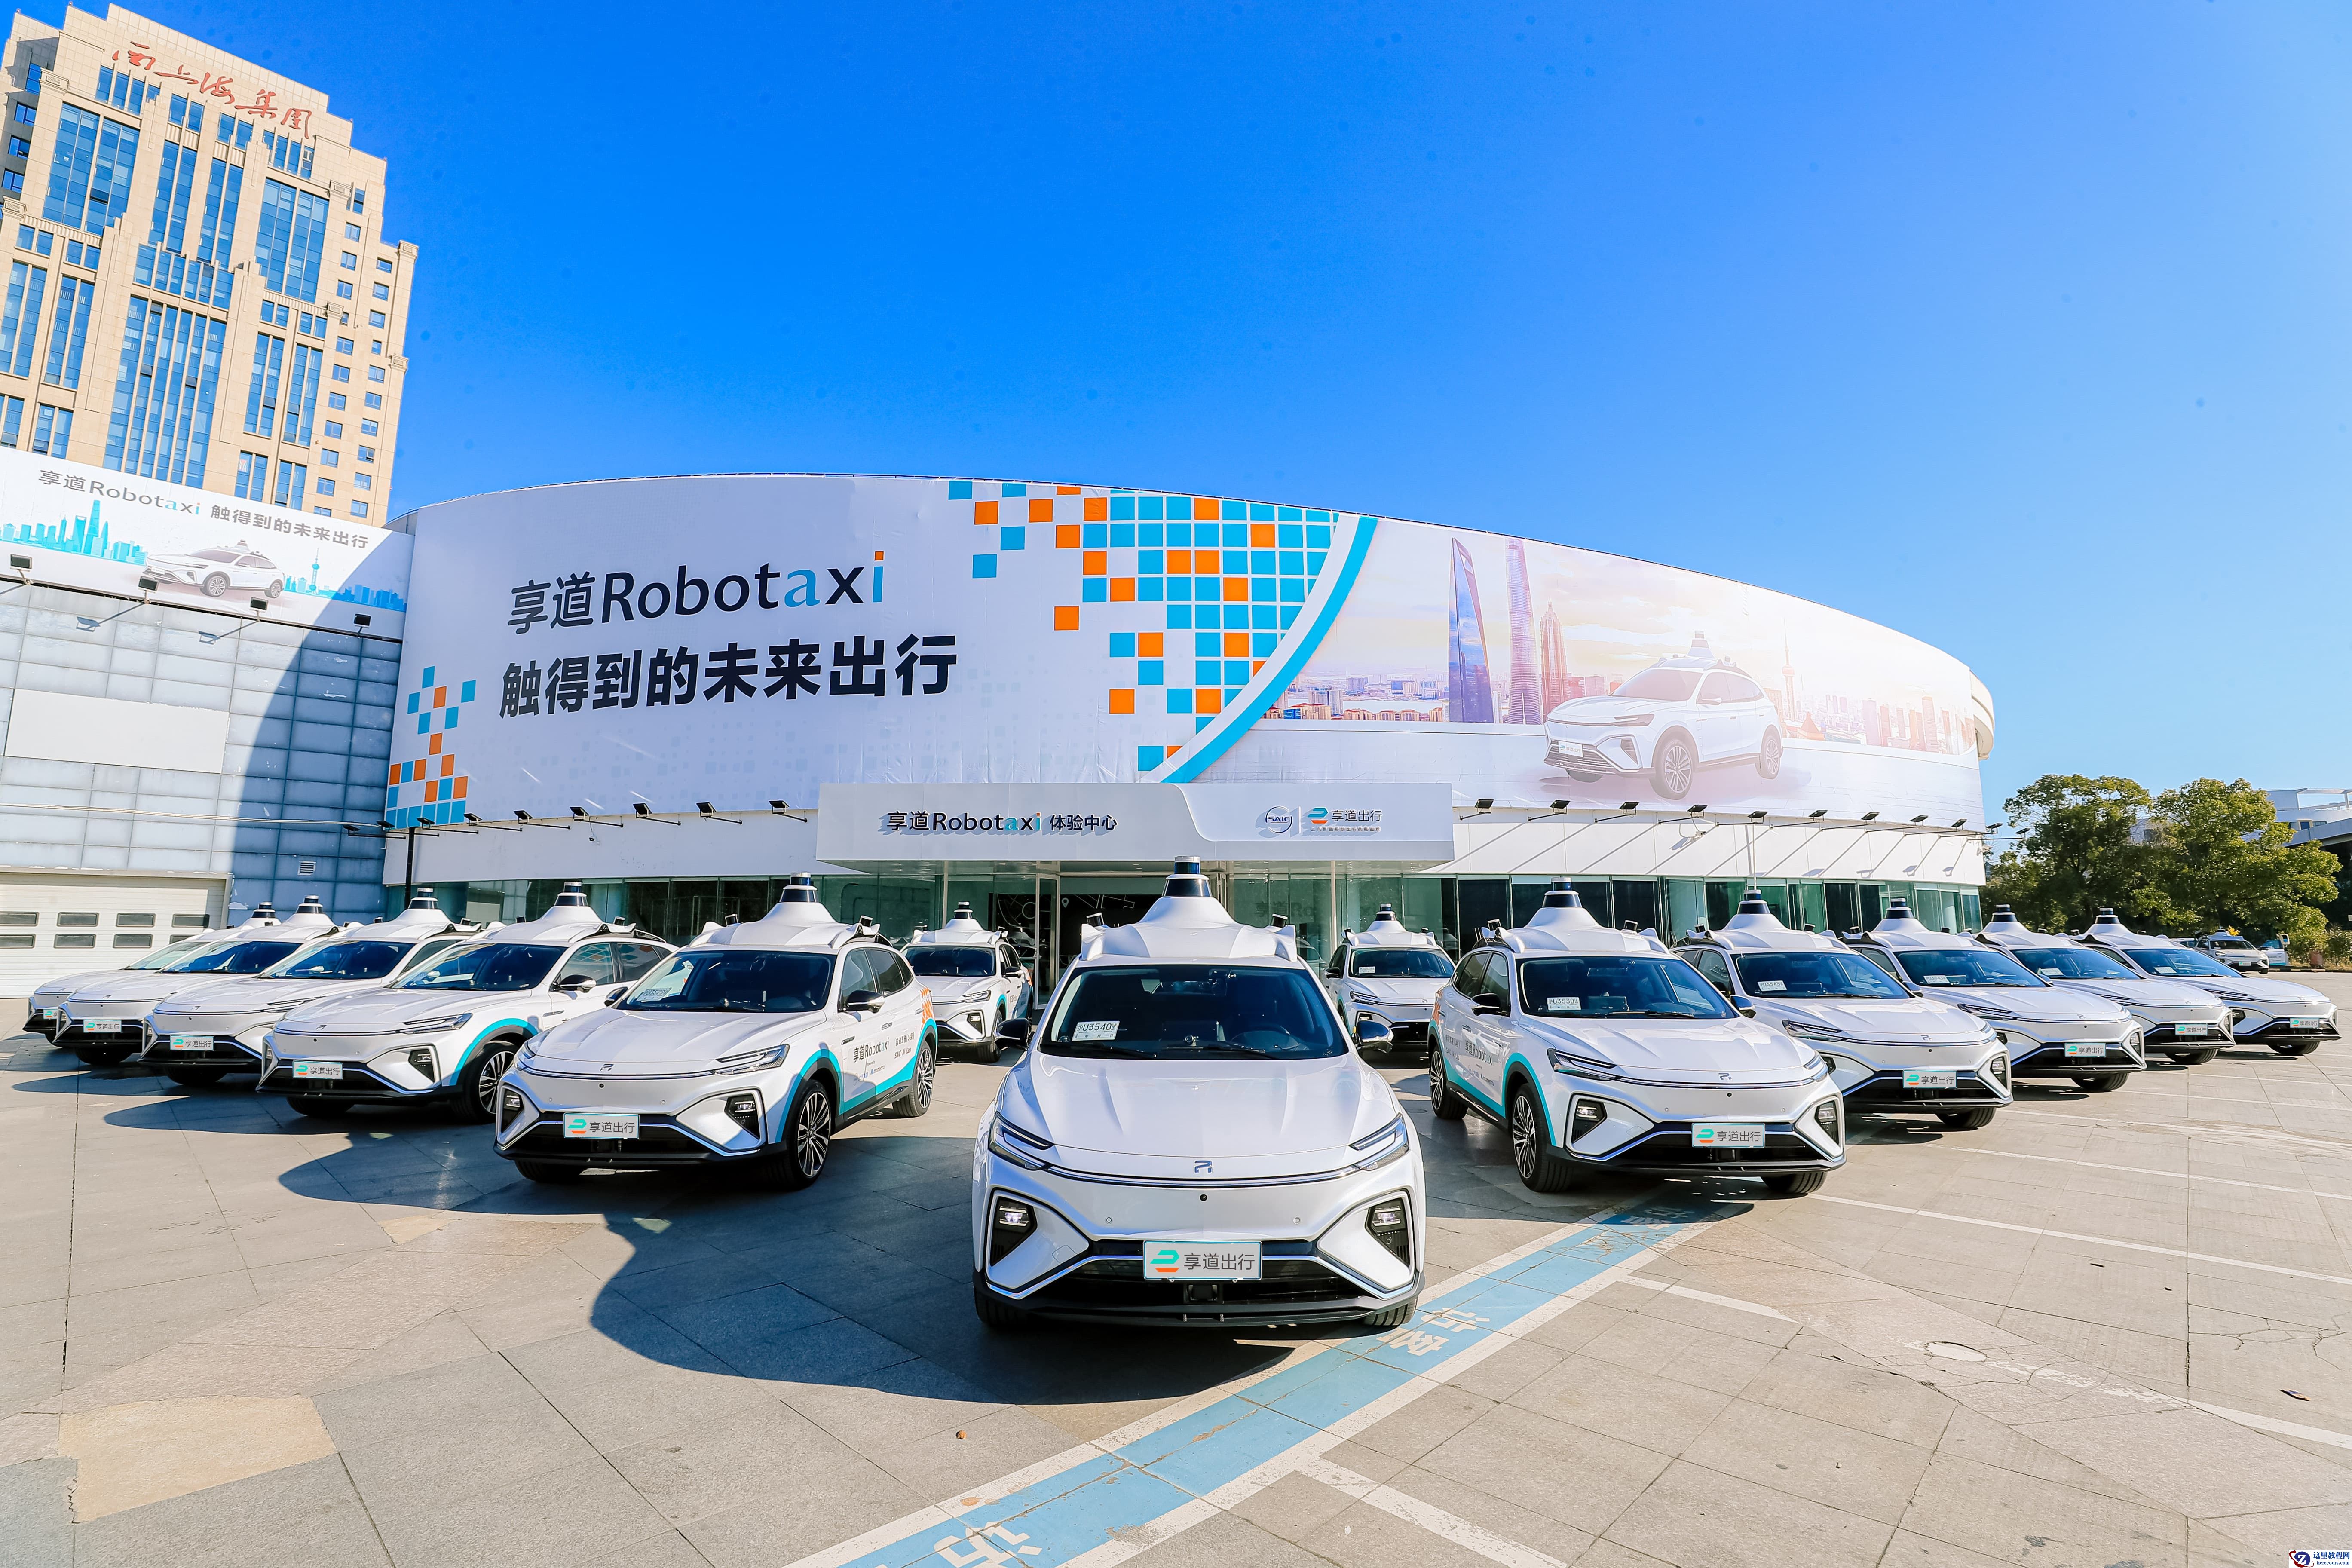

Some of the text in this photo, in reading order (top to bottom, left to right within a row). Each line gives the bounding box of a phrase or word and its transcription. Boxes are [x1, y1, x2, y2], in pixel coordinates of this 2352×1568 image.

[39, 470, 368, 549] 享道Robotaxi 触得到的未来出行
[508, 551, 884, 635] 享道Robotaxi
[499, 634, 956, 719] 触得到的未来出行
[887, 811, 1118, 831] 享道Robotaxi 体验中心
[1332, 810, 1382, 822] 享道出行
[309, 1067, 340, 1075] 享道出行
[1921, 1076, 1954, 1084] 享道出行
[589, 1121, 635, 1133] 享道出行
[1717, 1131, 1761, 1142] 享道出行
[1184, 1253, 1255, 1270] 享道出行
[1376, 1307, 1490, 1356] 访客
